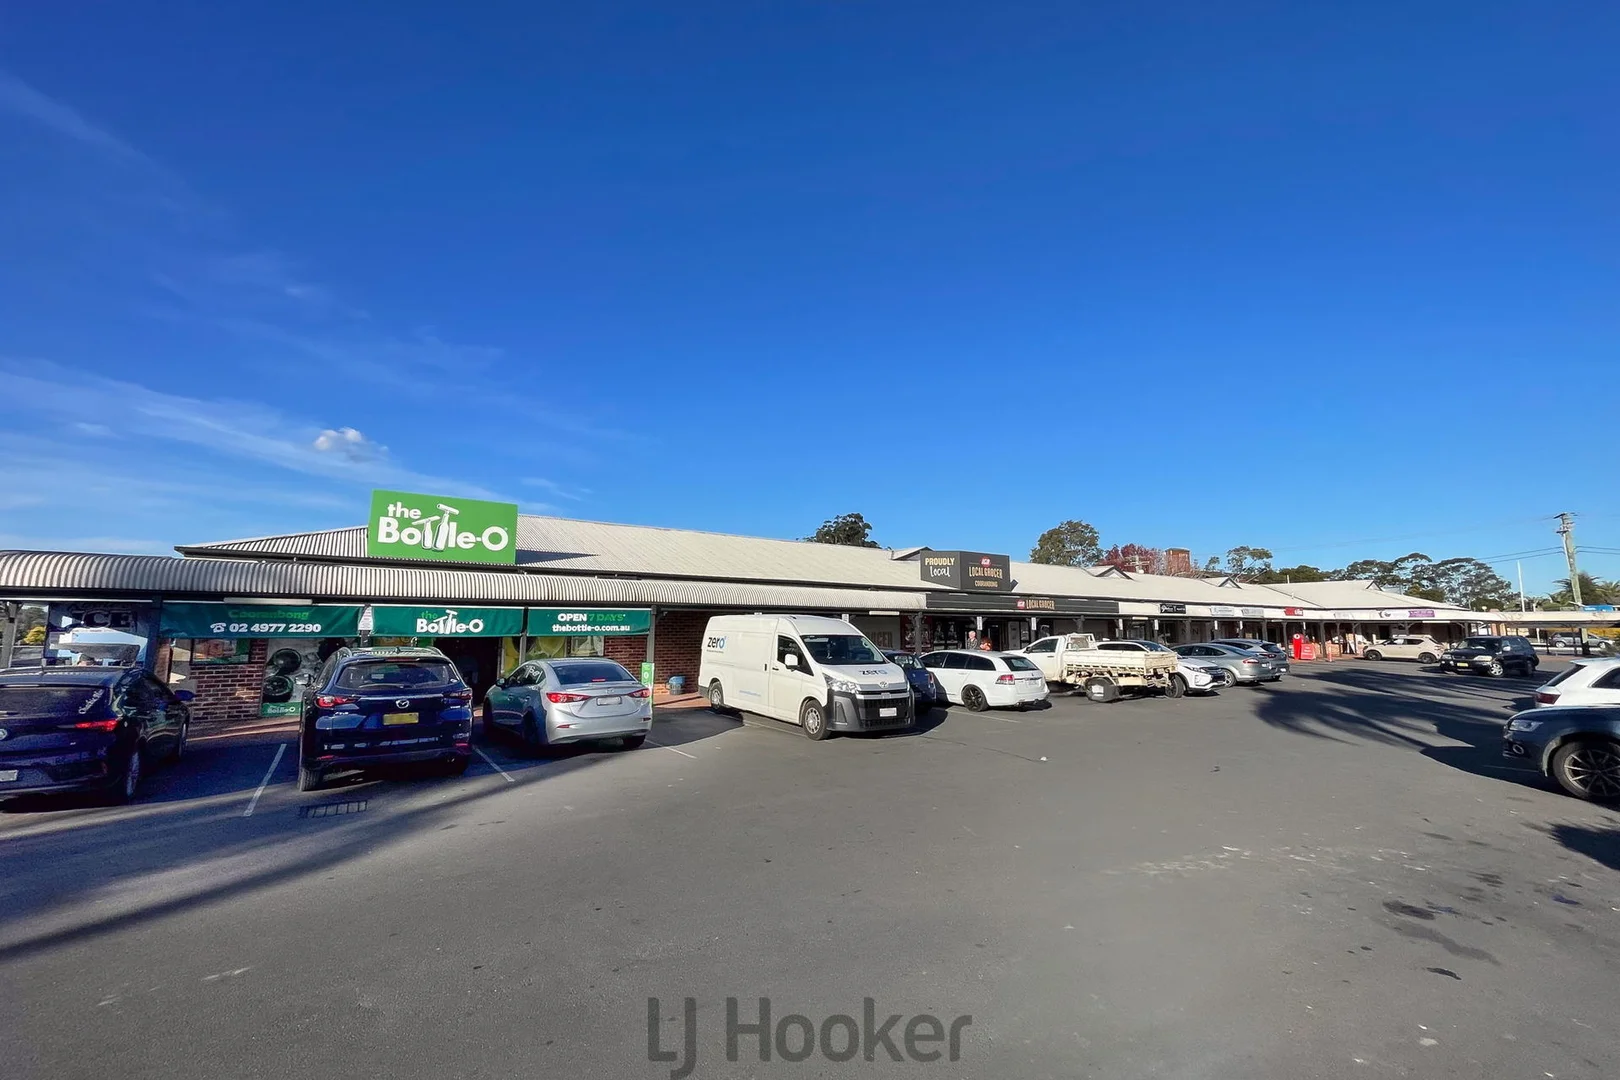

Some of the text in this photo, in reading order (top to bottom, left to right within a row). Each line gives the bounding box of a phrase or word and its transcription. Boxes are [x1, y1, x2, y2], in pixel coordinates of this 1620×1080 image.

[387, 502, 421, 519] the
[925, 557, 956, 566] PROUDLY
[968, 566, 1003, 579] LOCAL GROCER
[557, 613, 587, 622] OPEN
[588, 613, 595, 621] 7
[229, 623, 322, 633] 02 4977 2290
[552, 624, 630, 633] thebottle-o.com.au
[707, 636, 725, 649] zero
